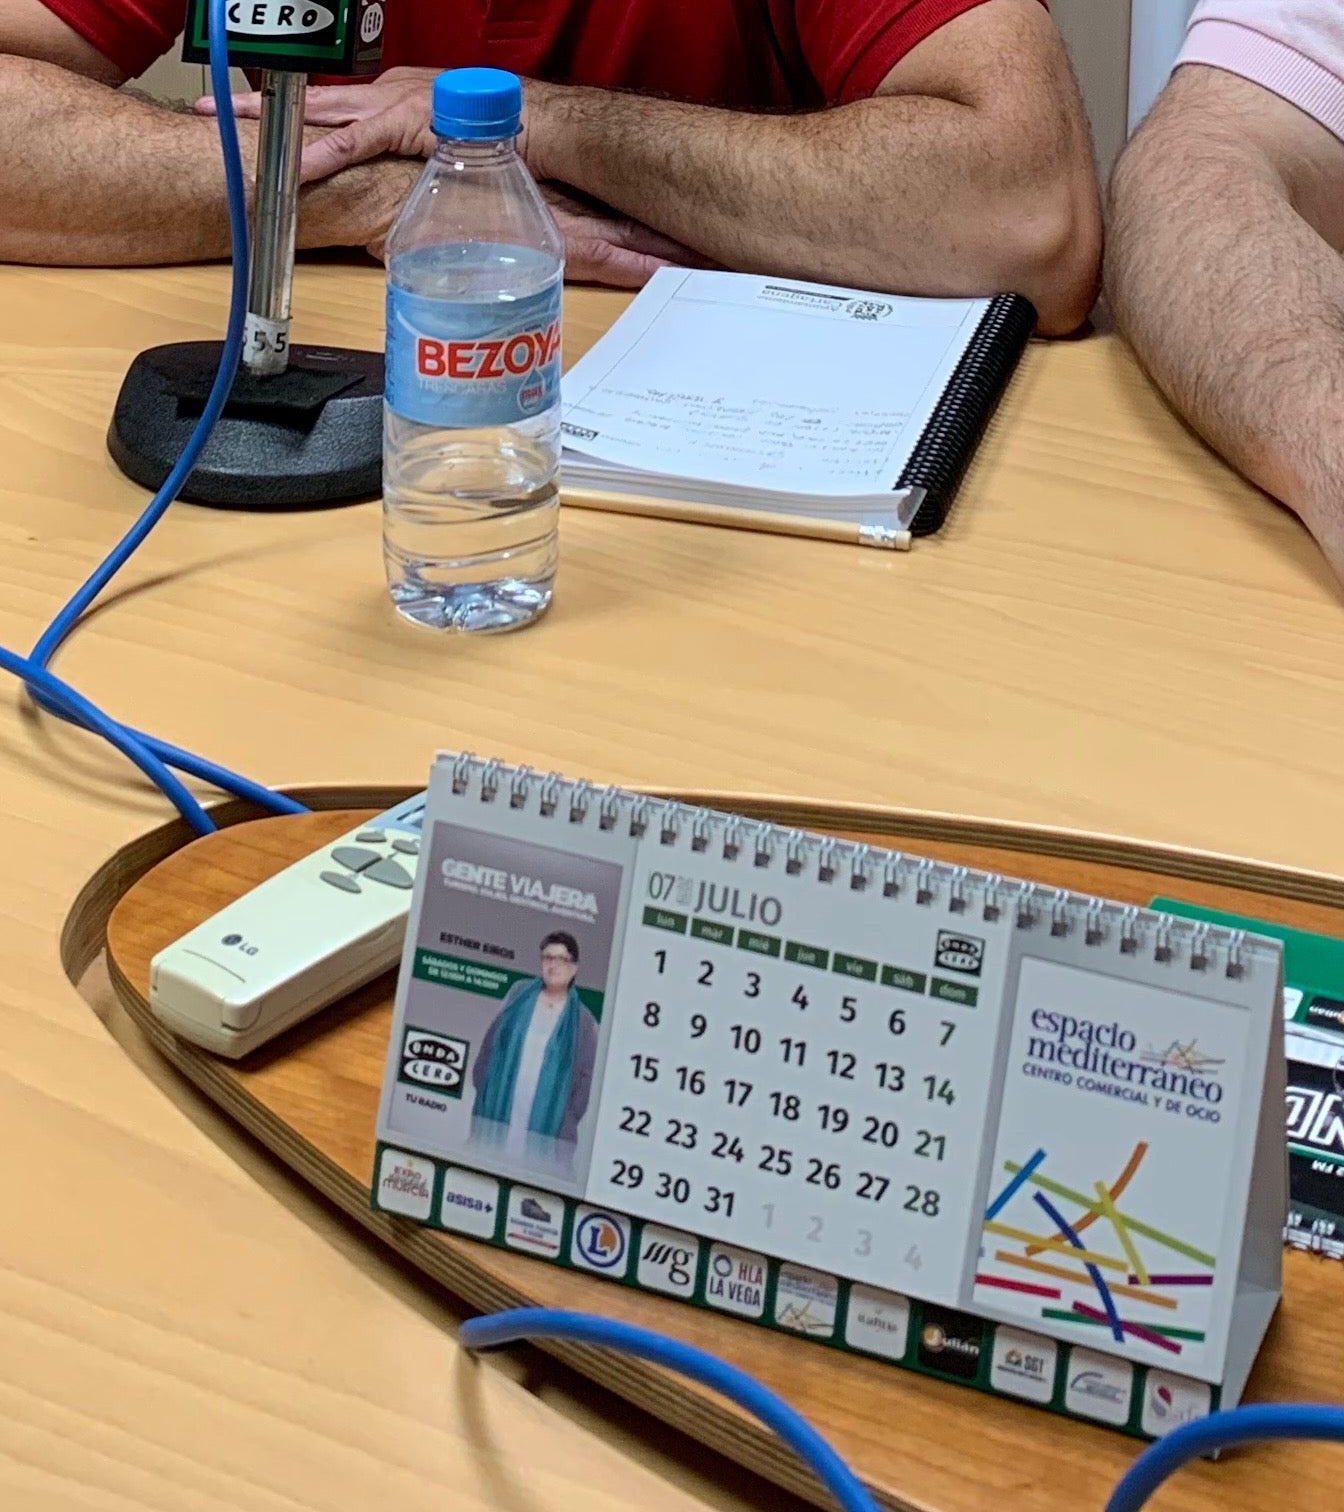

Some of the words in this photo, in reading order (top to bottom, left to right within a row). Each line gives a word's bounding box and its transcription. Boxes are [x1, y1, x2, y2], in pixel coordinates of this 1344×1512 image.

[227, 2, 318, 28] CERO
[441, 857, 507, 887] GENTE
[510, 873, 599, 915] VIAJERA
[648, 871, 676, 902] 07
[693, 880, 783, 927] JULIO
[240, 940, 260, 957] LG
[654, 949, 667, 975] 1
[697, 960, 714, 987] 2
[744, 972, 761, 999] 3
[791, 984, 809, 1011] 4
[840, 996, 857, 1023] 5
[888, 1009, 906, 1036] 6
[940, 1020, 956, 1047] 7
[412, 1040, 457, 1064] ONDA
[643, 1001, 661, 1028] 8
[690, 1014, 707, 1039] 9
[730, 1024, 762, 1055] 10
[779, 1037, 807, 1067] 11
[827, 1050, 857, 1080] 12
[875, 1062, 905, 1093] 13
[923, 1075, 955, 1106] 14
[1031, 1007, 1136, 1052] espacio
[630, 1054, 659, 1083] 15
[676, 1066, 706, 1096] 16
[724, 1079, 753, 1107] 17
[769, 1091, 801, 1122] 18
[817, 1104, 849, 1133] 19
[862, 1116, 899, 1149] 20
[914, 1129, 946, 1162] 21
[1022, 1061, 1074, 1086] CENTRO
[1076, 1071, 1149, 1106] COMERCIAL
[1153, 1095, 1162, 1108] Y
[1165, 1097, 1182, 1114] DE
[1185, 1101, 1222, 1124] OCIO
[619, 1106, 652, 1137] 22
[664, 1118, 698, 1150] 23
[711, 1131, 744, 1163] 24
[758, 1144, 793, 1176] 25
[805, 1158, 841, 1190] 26
[856, 1171, 890, 1202] 27
[903, 1184, 940, 1217] 28
[1311, 1159, 1334, 1176] FM
[446, 1191, 483, 1212] asisa
[610, 1159, 645, 1190] 29
[655, 1172, 690, 1204] 30
[703, 1186, 735, 1218] 31
[762, 1203, 774, 1229] 1
[807, 1216, 824, 1242] 2
[855, 1230, 872, 1256] 3
[904, 1244, 923, 1272] 4
[709, 1274, 725, 1296] LA
[728, 1280, 761, 1308] VEGA
[737, 1261, 764, 1286] HLA
